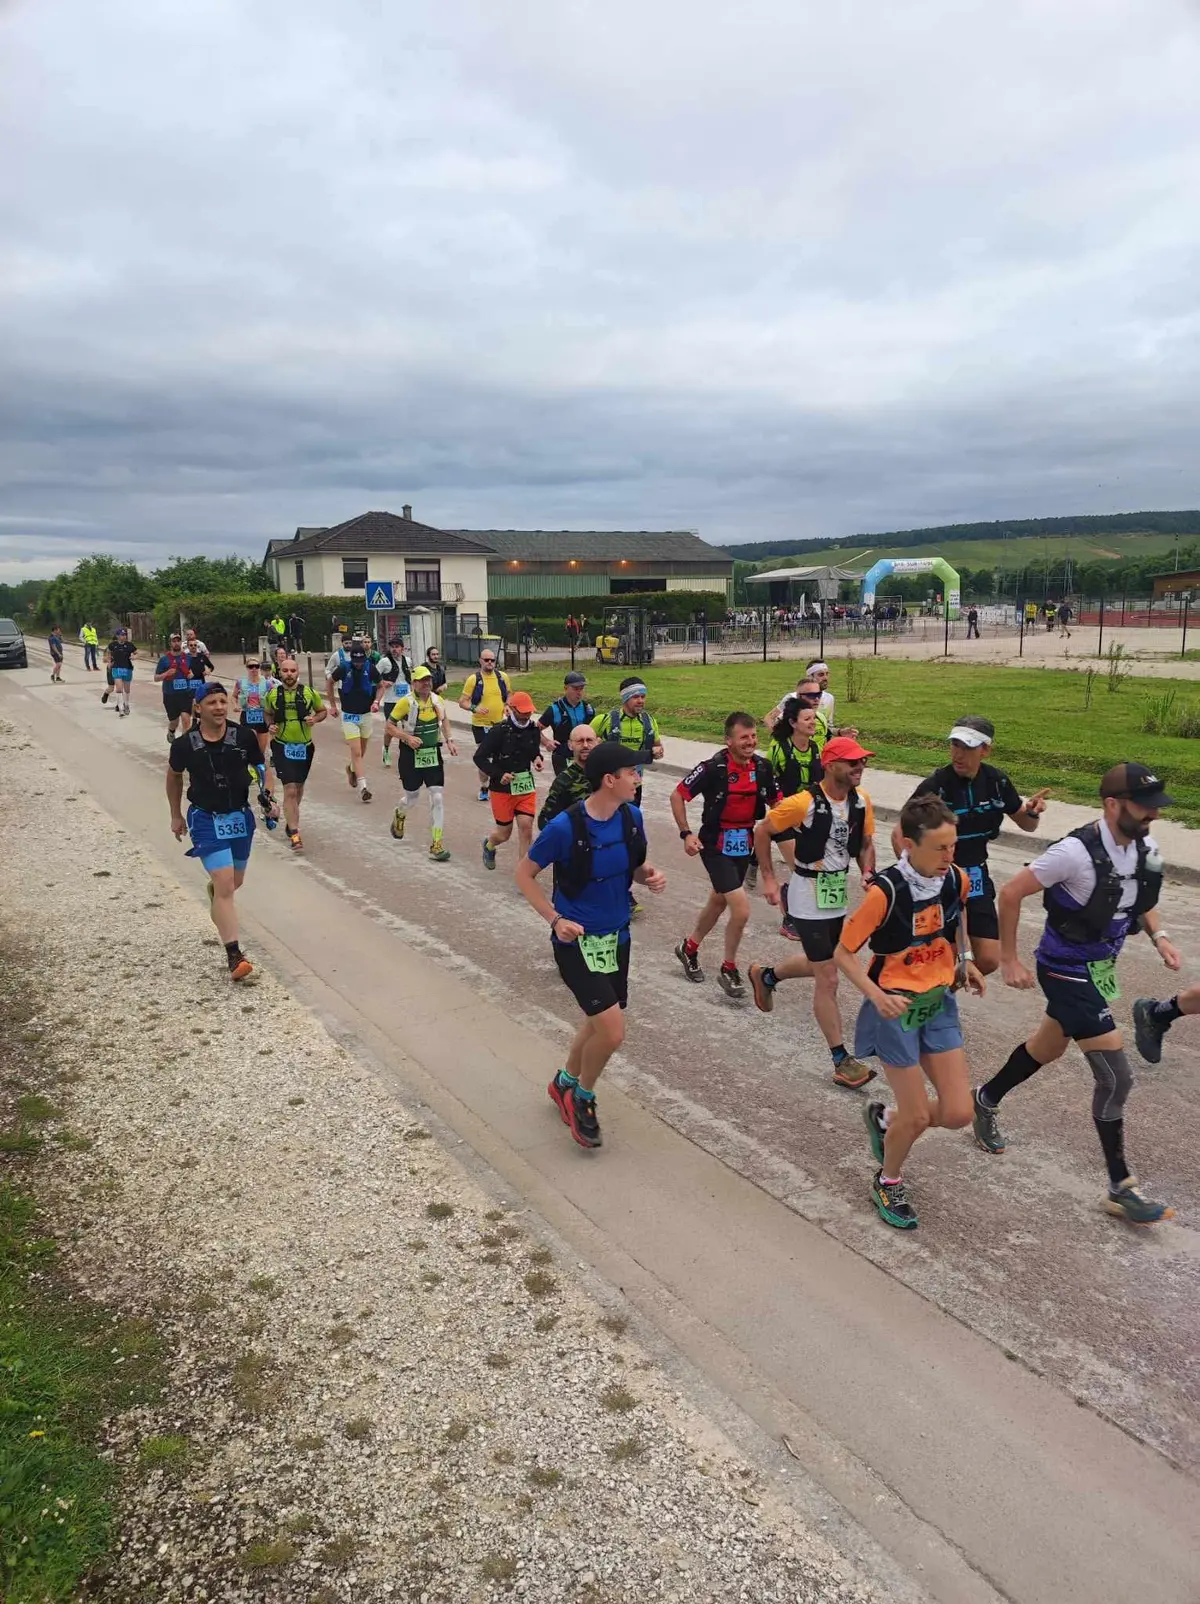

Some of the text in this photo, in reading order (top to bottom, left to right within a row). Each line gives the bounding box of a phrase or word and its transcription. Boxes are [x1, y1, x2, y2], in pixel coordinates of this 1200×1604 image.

[286, 749, 306, 758] 5462
[218, 822, 246, 836] 5353
[725, 840, 748, 853] 545
[968, 879, 982, 892] 38
